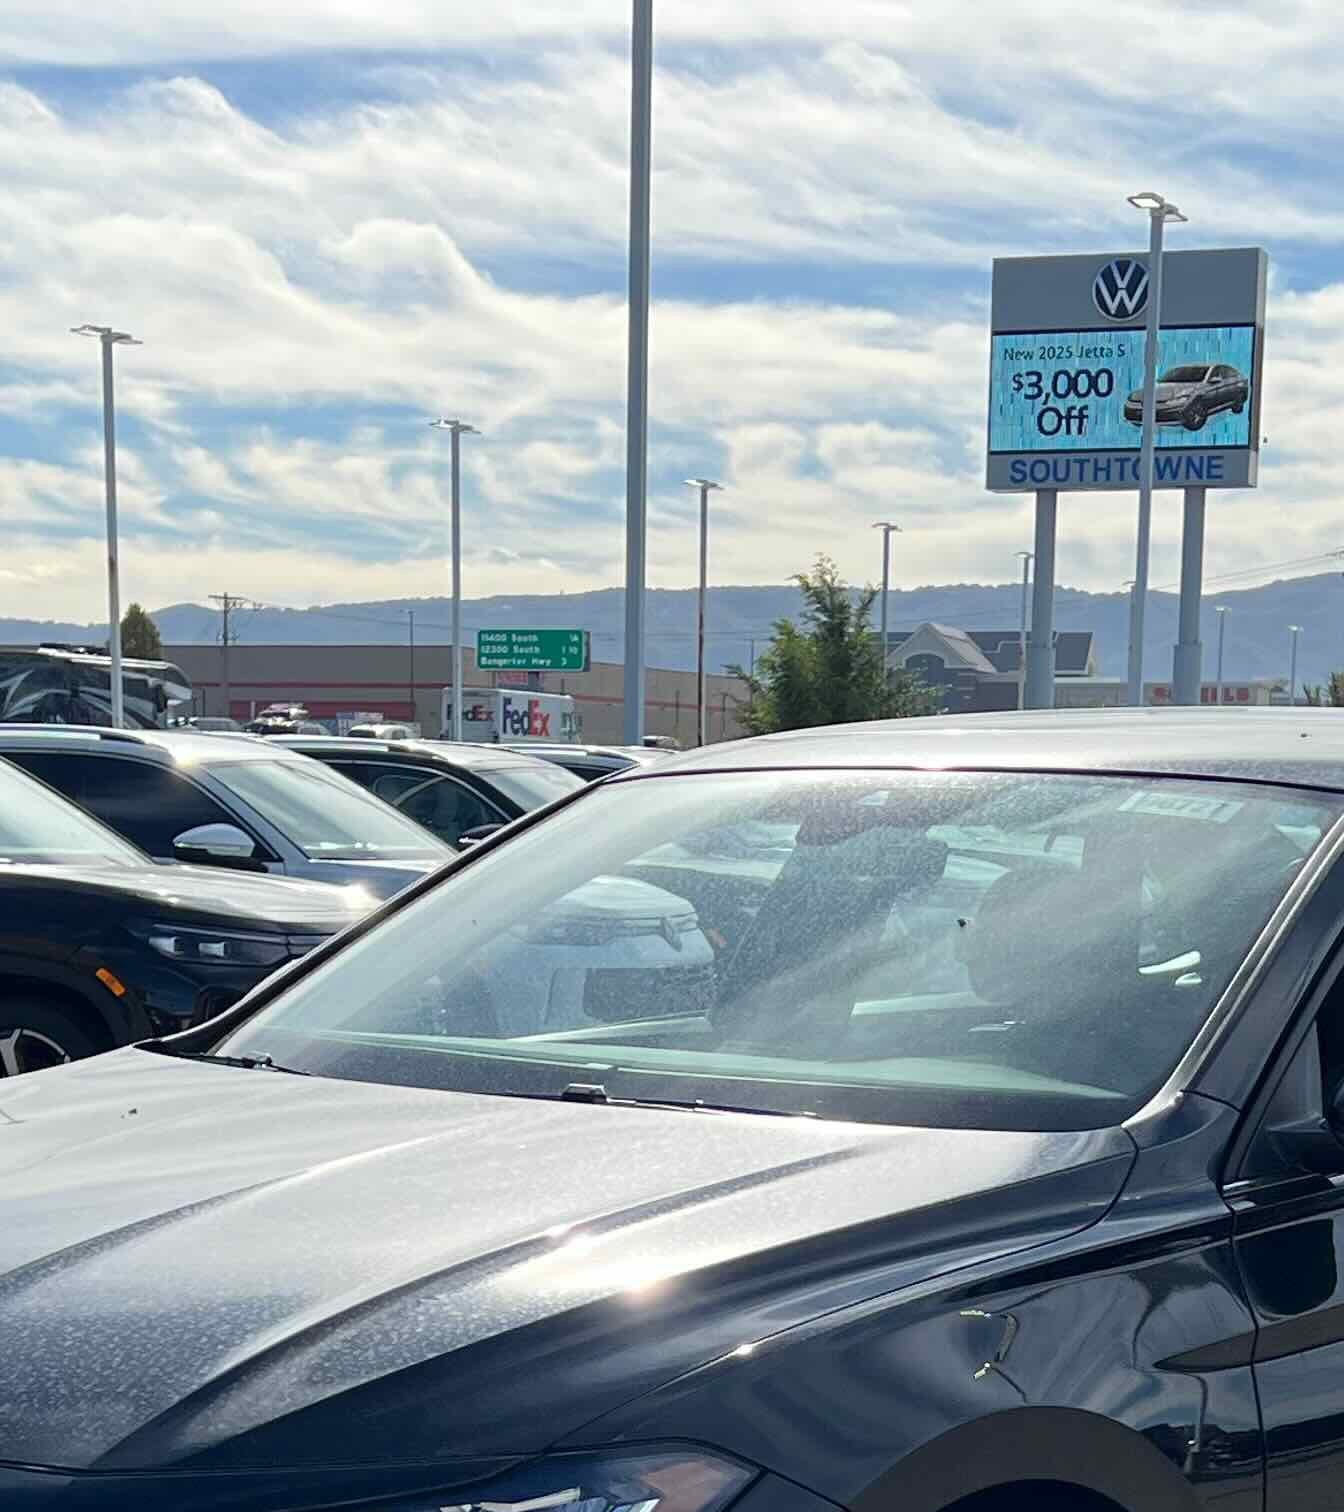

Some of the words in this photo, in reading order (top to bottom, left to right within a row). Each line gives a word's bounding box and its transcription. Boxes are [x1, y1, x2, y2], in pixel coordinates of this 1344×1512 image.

[1004, 348, 1034, 361] New
[1039, 346, 1073, 360] 2025
[1076, 344, 1114, 359] Jetta
[1118, 343, 1126, 358] S
[1012, 368, 1114, 406] $3,000
[1037, 404, 1088, 436] Off
[512, 633, 539, 642] South
[513, 645, 540, 654] South
[447, 704, 495, 721] FdEx
[503, 697, 550, 737] FedEx
